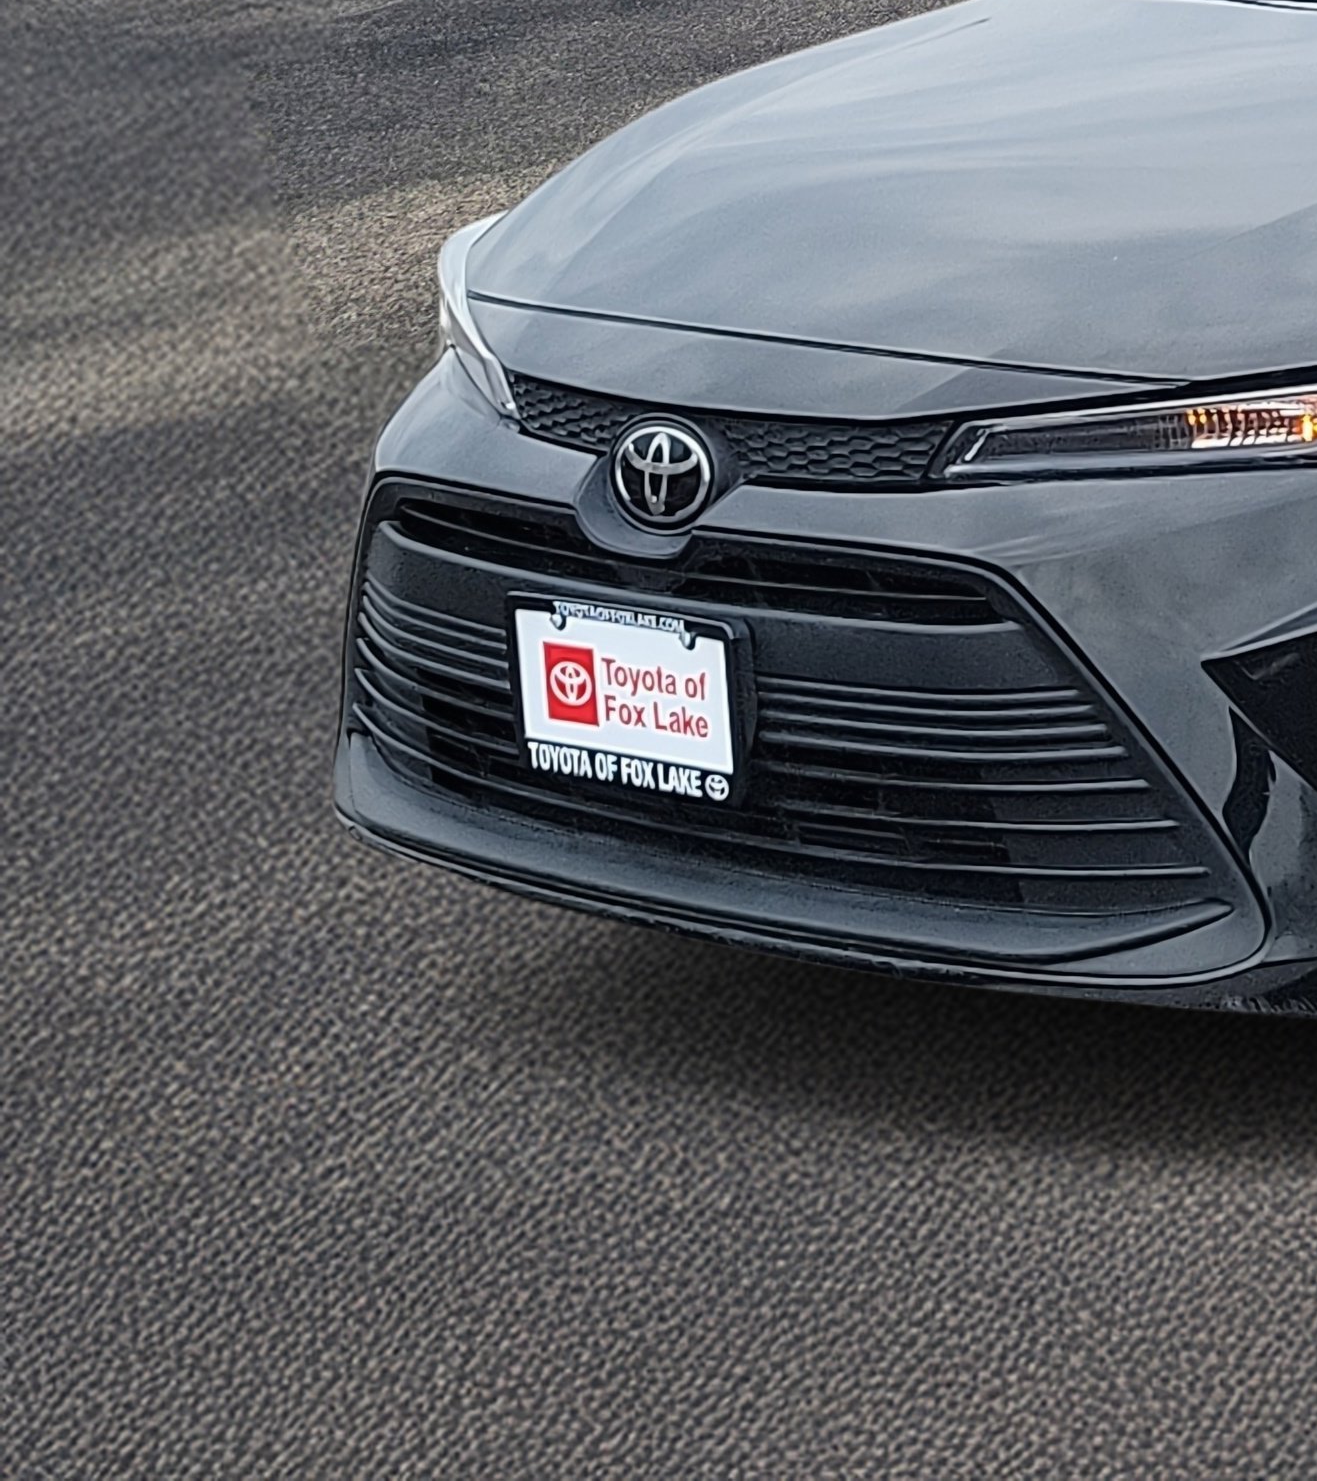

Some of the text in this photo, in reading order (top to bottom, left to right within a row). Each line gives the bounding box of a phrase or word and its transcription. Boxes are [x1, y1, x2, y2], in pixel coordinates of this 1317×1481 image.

[601, 657, 706, 700] Toyota of
[603, 695, 709, 737] Fox Lake
[527, 742, 703, 797] TOYOTA OF FOX LAKE
